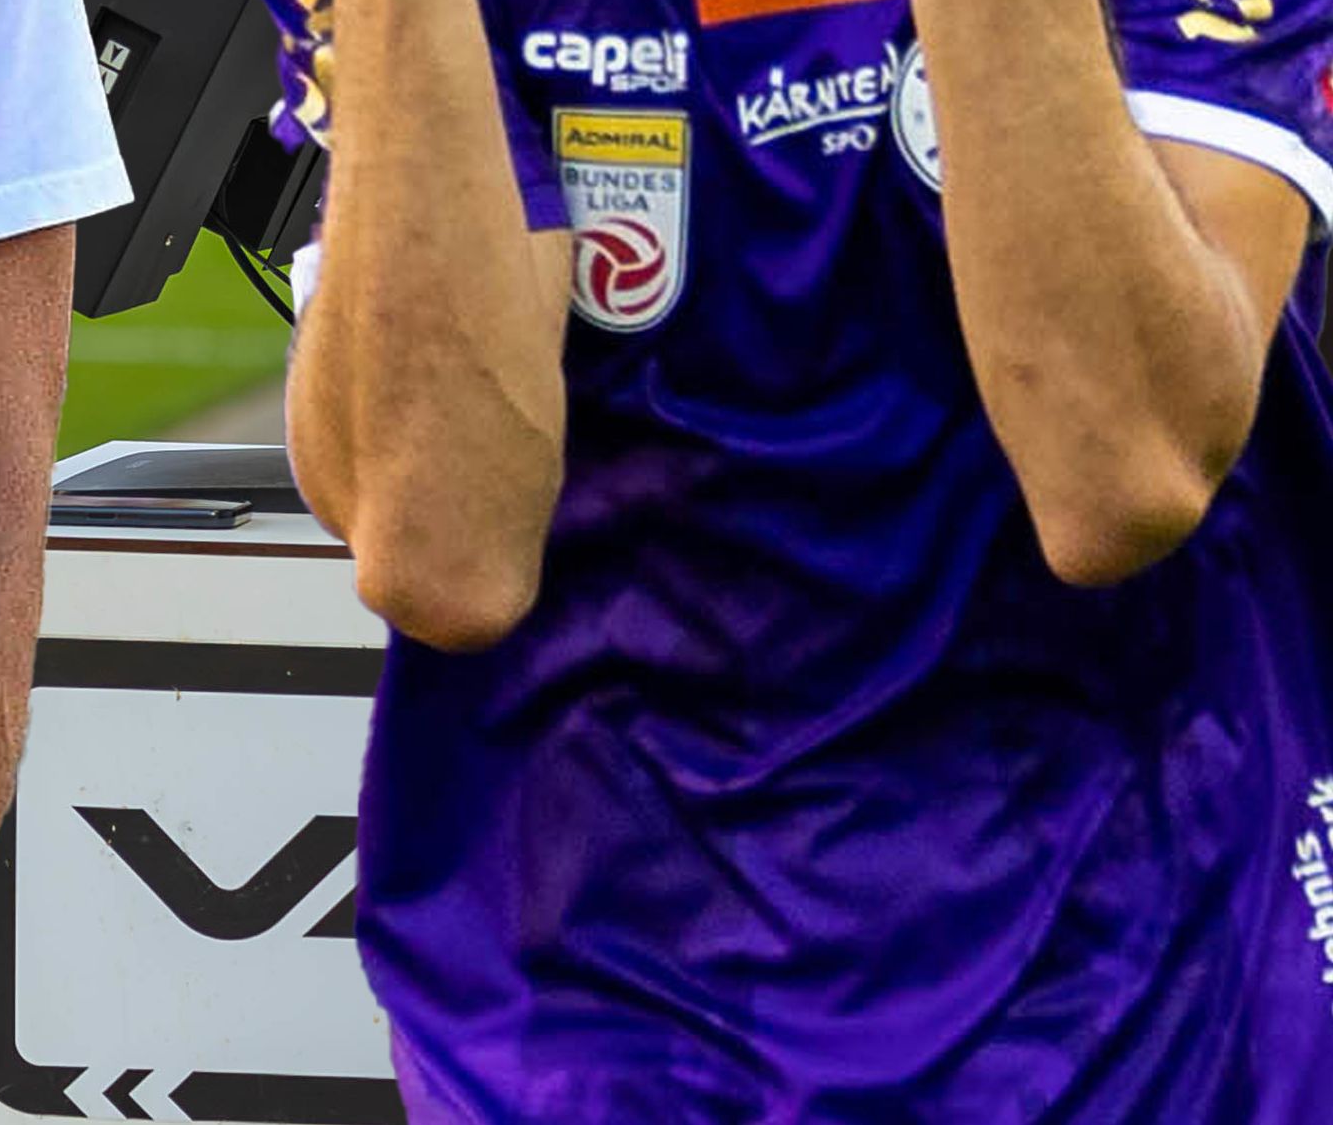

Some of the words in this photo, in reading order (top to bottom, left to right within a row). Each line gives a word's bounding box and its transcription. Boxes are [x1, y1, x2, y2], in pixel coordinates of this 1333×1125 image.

[565, 128, 678, 151] ADMIRAL
[564, 167, 676, 193] BUNDES
[587, 193, 649, 212] LIGA
